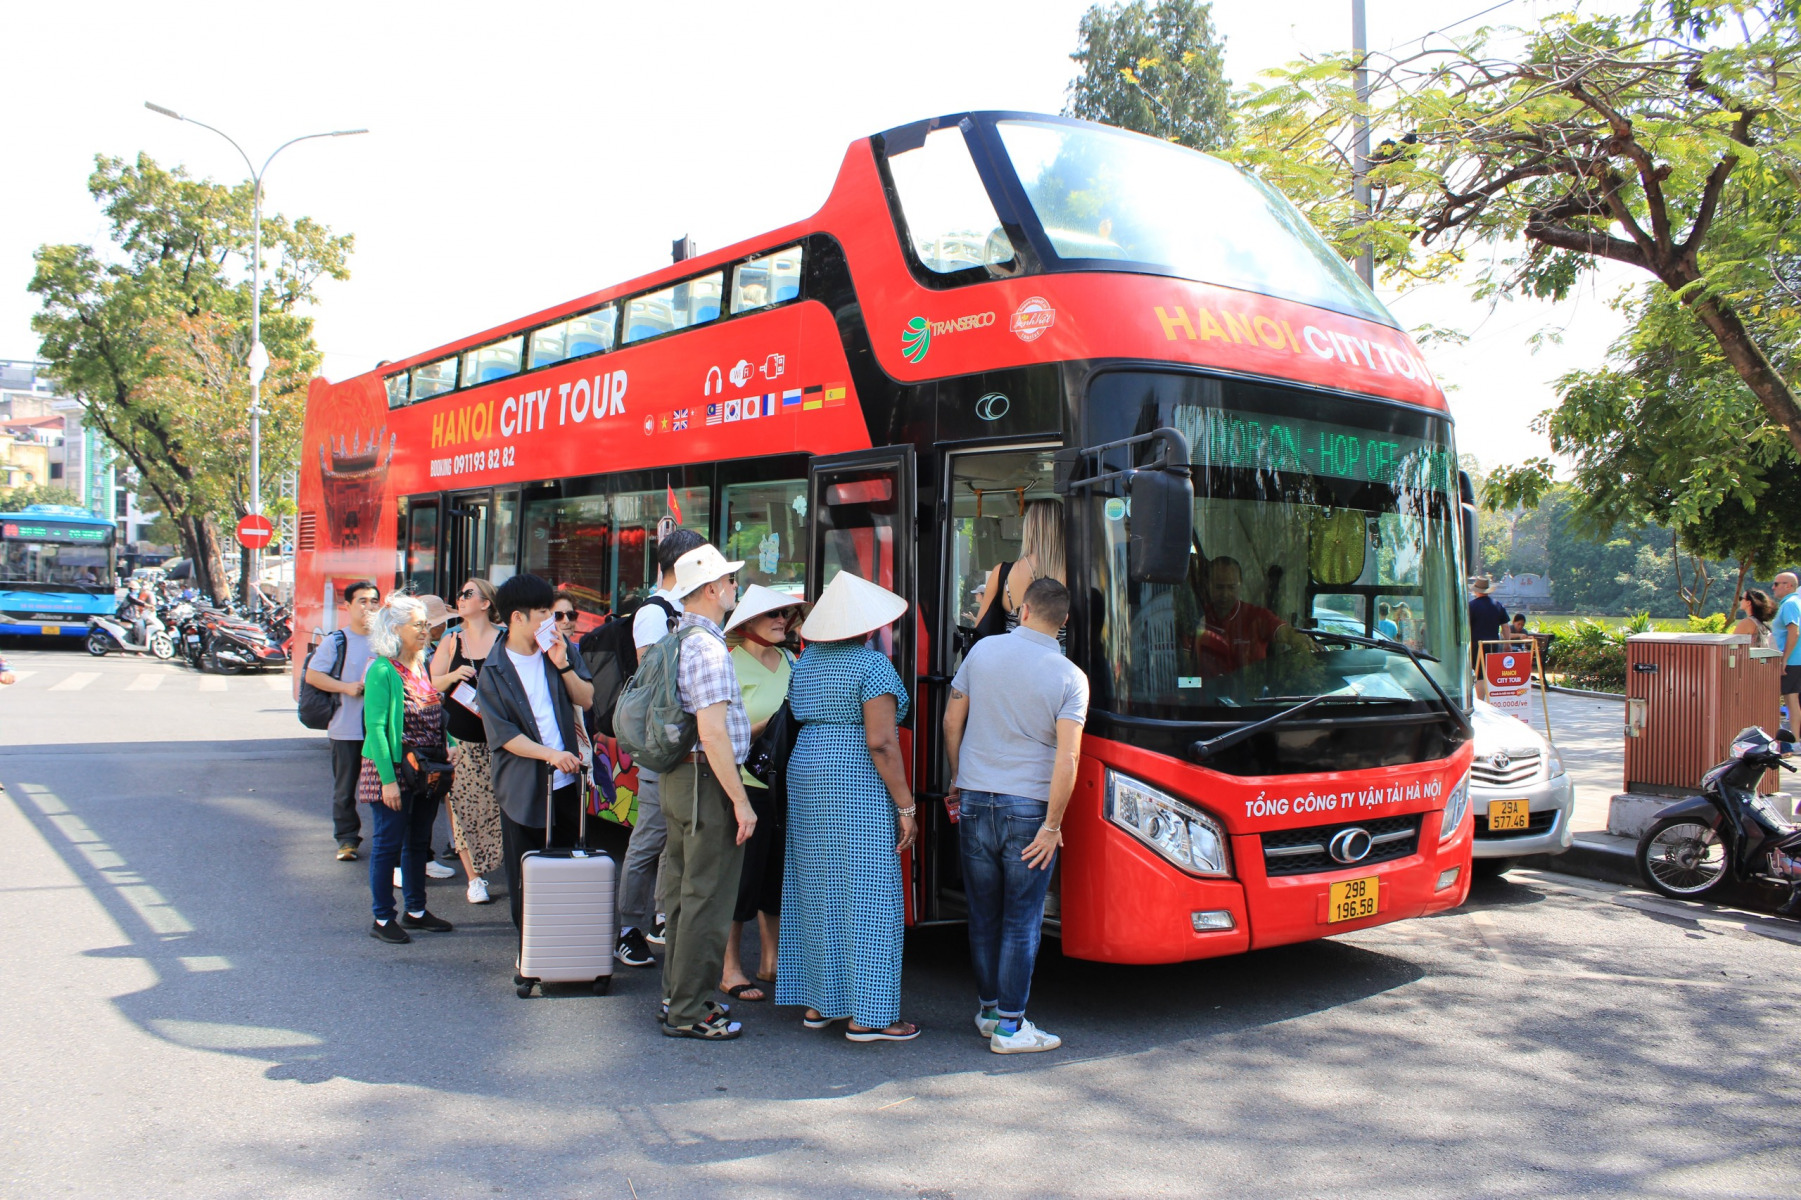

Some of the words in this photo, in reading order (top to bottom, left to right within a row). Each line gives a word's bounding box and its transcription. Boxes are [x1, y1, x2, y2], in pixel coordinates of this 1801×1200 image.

[931, 311, 996, 337] TRANSERCO
[1153, 305, 1302, 354] HANOI
[1303, 325, 1377, 370] CITY
[431, 400, 495, 449] HANOI
[500, 387, 552, 437] CITY
[558, 369, 628, 426] TOUR
[430, 458, 452, 477] BOOKING
[453, 451, 485, 475] 091193
[487, 448, 500, 470] 82
[502, 445, 515, 468] 82
[1211, 416, 1260, 465] HOP
[1269, 424, 1301, 470] ON
[1320, 431, 1361, 477] HOP
[1366, 439, 1399, 481] OFF
[1245, 791, 1289, 817] TỔNG
[1293, 792, 1337, 814] CÔNG
[1340, 792, 1355, 809] TY
[1358, 786, 1383, 810] VẬN
[1386, 781, 1403, 803] TẢI
[1405, 780, 1421, 801] HÀ
[1423, 778, 1442, 802] NỘI
[1501, 801, 1518, 814] 29A
[1494, 815, 1525, 829] 577.46
[1344, 880, 1366, 900] 29B
[1337, 897, 1374, 919] 196.58
